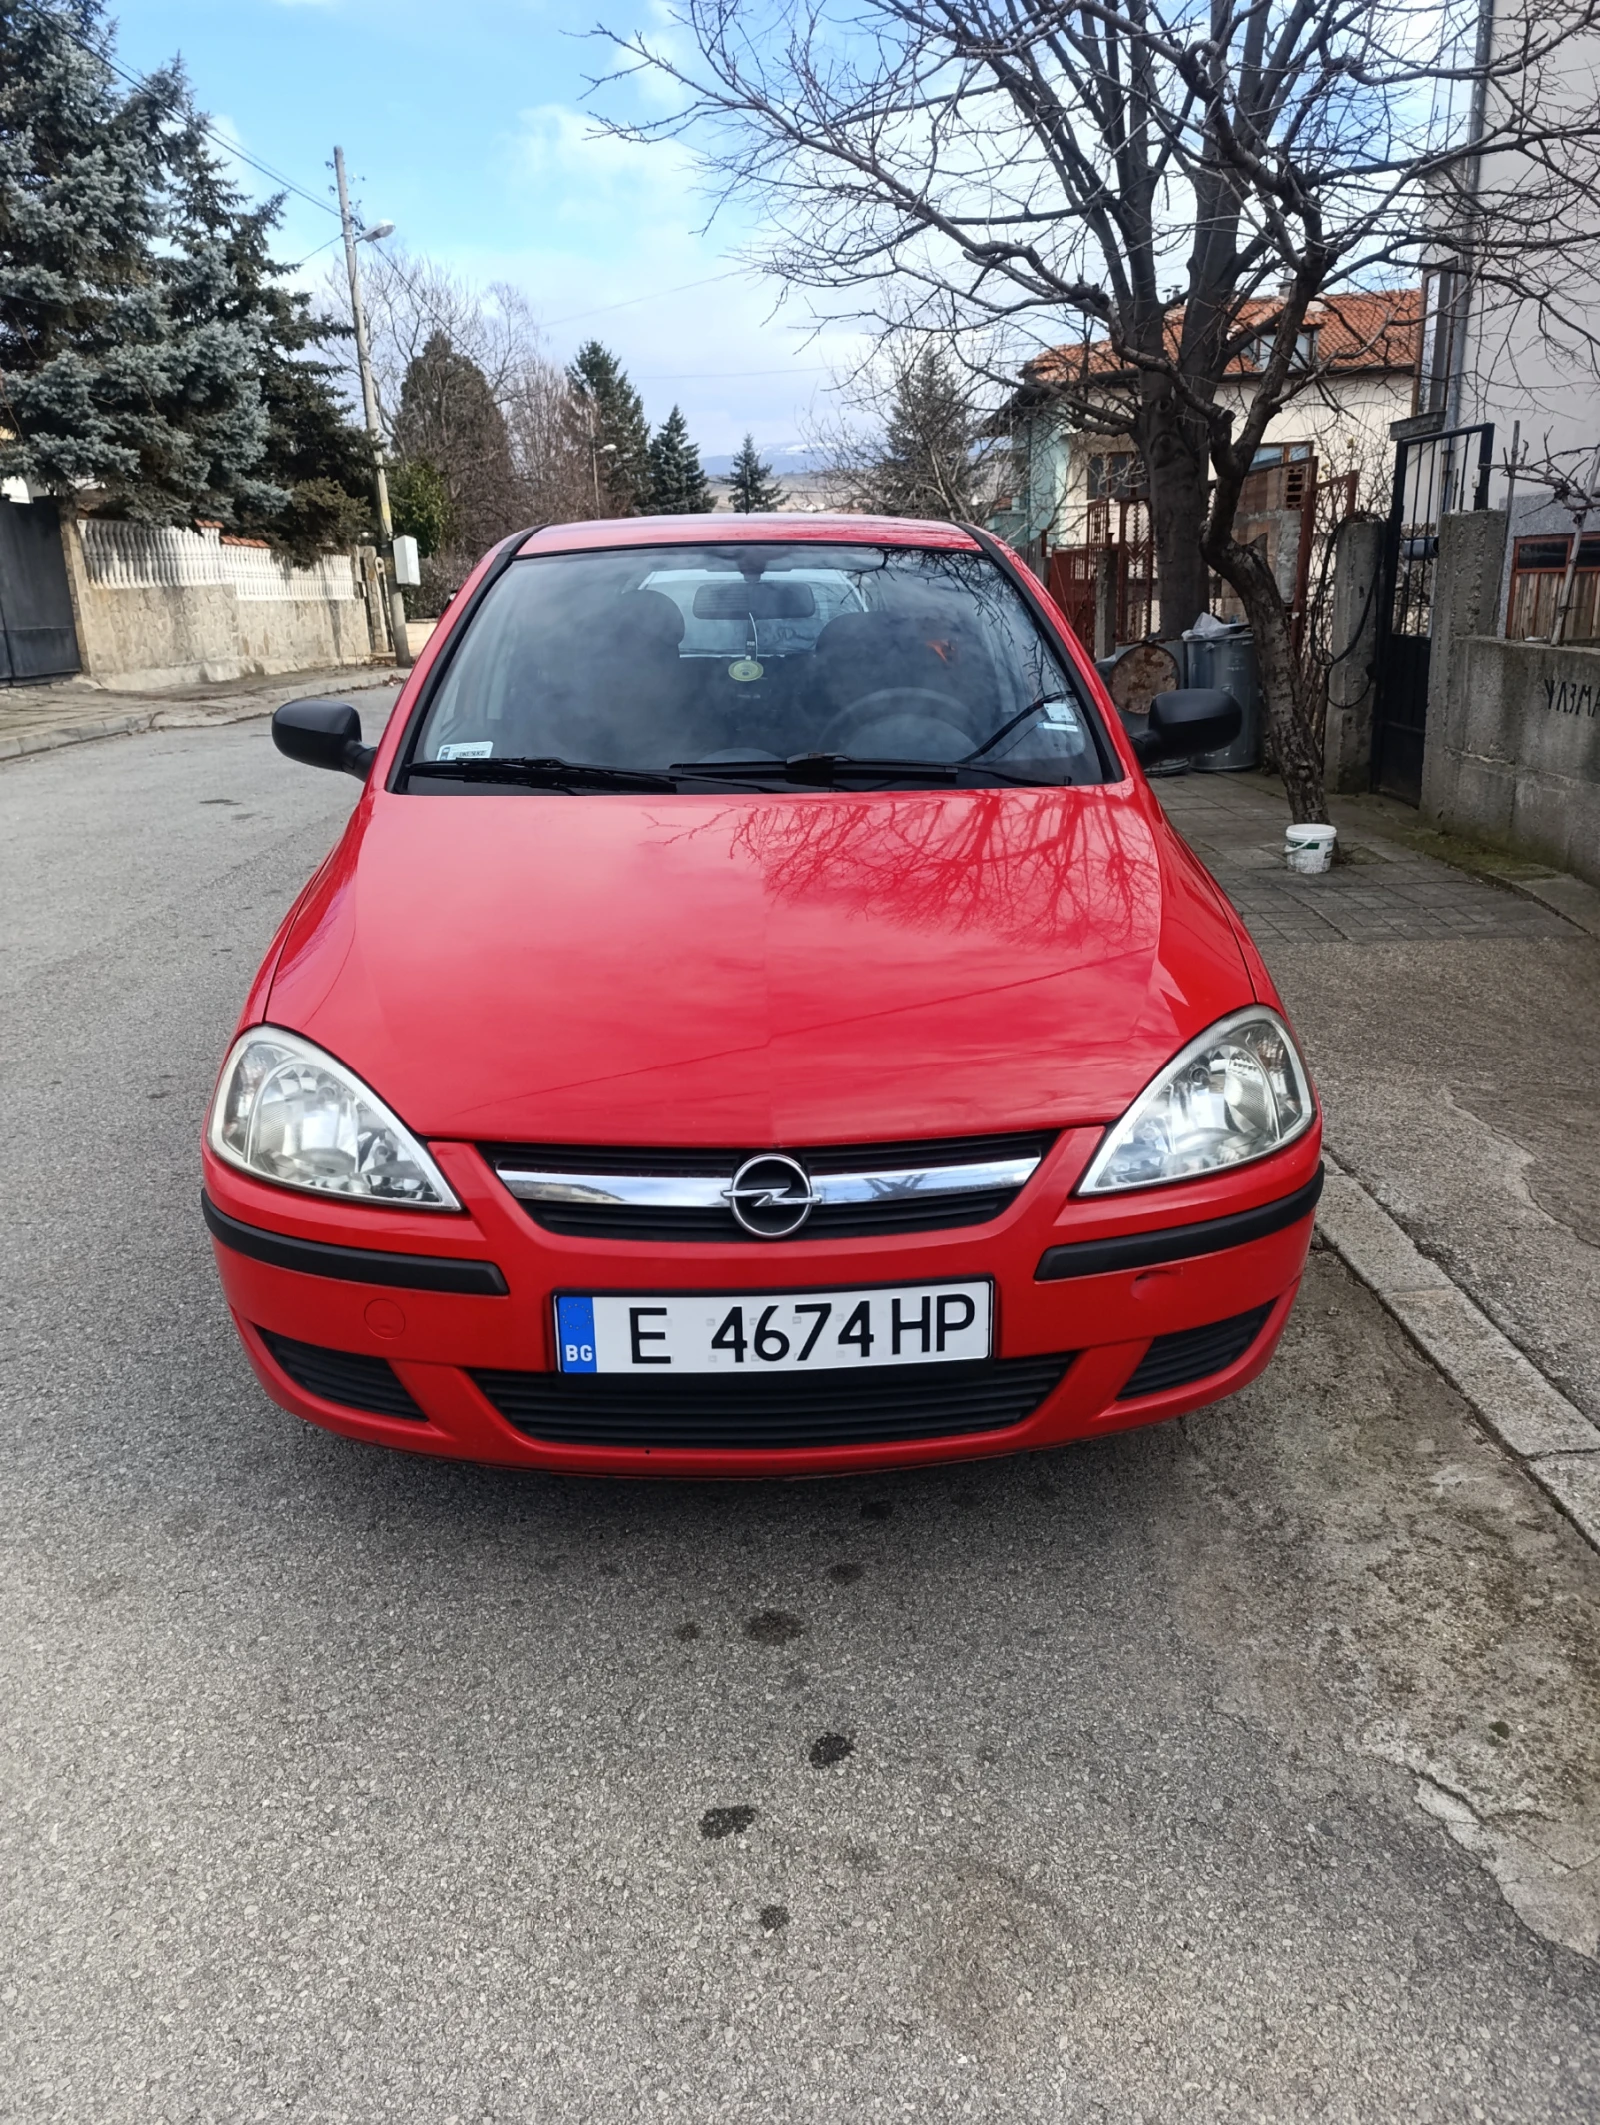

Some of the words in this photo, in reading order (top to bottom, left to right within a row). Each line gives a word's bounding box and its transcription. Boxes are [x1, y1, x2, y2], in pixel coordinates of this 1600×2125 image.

[629, 1307, 672, 1364] E
[711, 1300, 875, 1363] 4674
[891, 1293, 976, 1355] HP
[565, 1344, 593, 1362] BG
